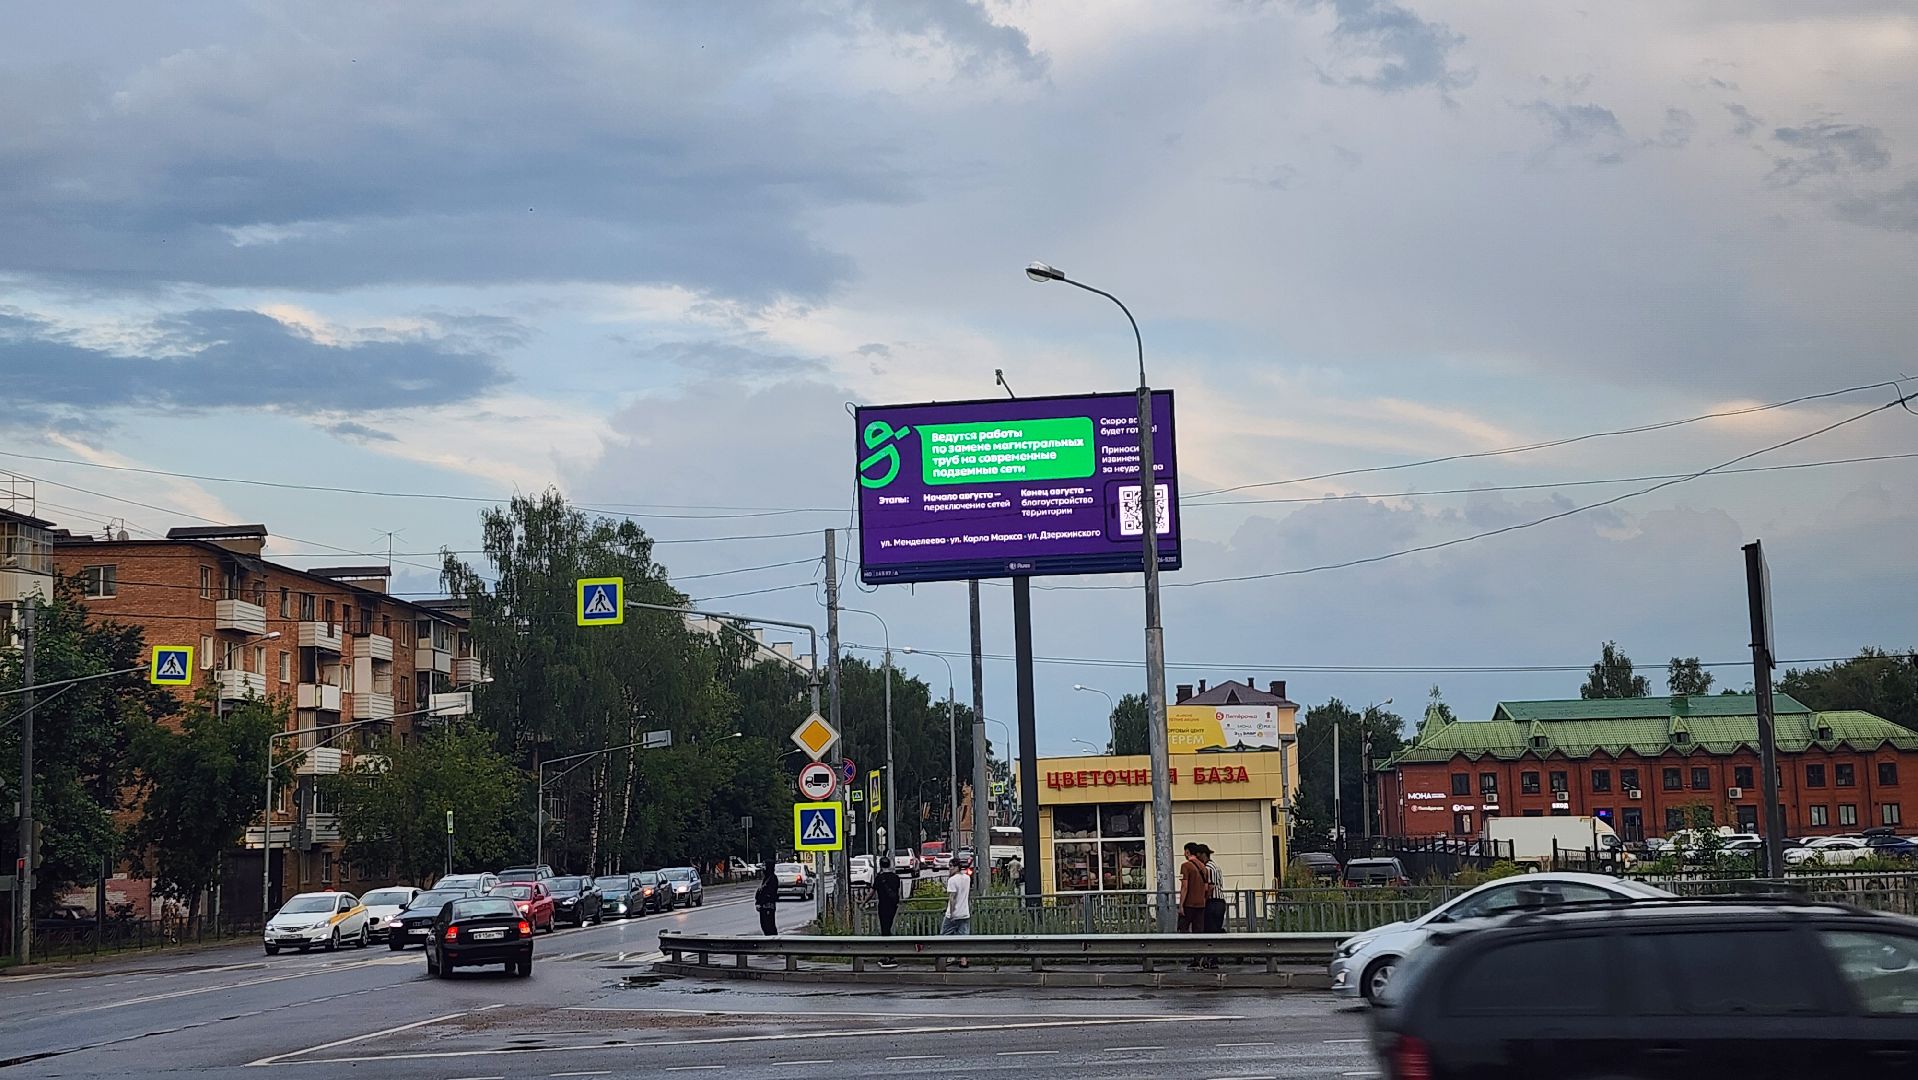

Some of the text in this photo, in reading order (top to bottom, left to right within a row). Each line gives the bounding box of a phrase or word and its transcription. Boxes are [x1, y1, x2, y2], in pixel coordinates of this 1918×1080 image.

[1100, 418, 1127, 426] Скоро
[931, 429, 1023, 443] Ведутся работы
[1100, 428, 1125, 436] будет
[932, 438, 1085, 454] по замене магистральных
[1101, 445, 1140, 455] Приноси
[932, 451, 1057, 467] труб на современные
[932, 465, 1026, 478] подземные сети
[1114, 464, 1164, 474] неудова
[923, 493, 958, 502] Начало
[959, 491, 994, 501] августа
[1021, 488, 1049, 498] Конец
[1049, 487, 1085, 497] августа
[879, 496, 910, 505] Этапы:
[924, 499, 1011, 512] переключение сетей
[1021, 496, 1094, 507] благоустройство
[1021, 507, 1073, 517] территории
[880, 529, 1101, 548] ул. Менделеева ул. Карла Маркса ул. Дзержинского
[1046, 765, 1250, 791] ЦВЕТОЧНЯ БАЗА
[1407, 792, 1432, 800] МОНА
